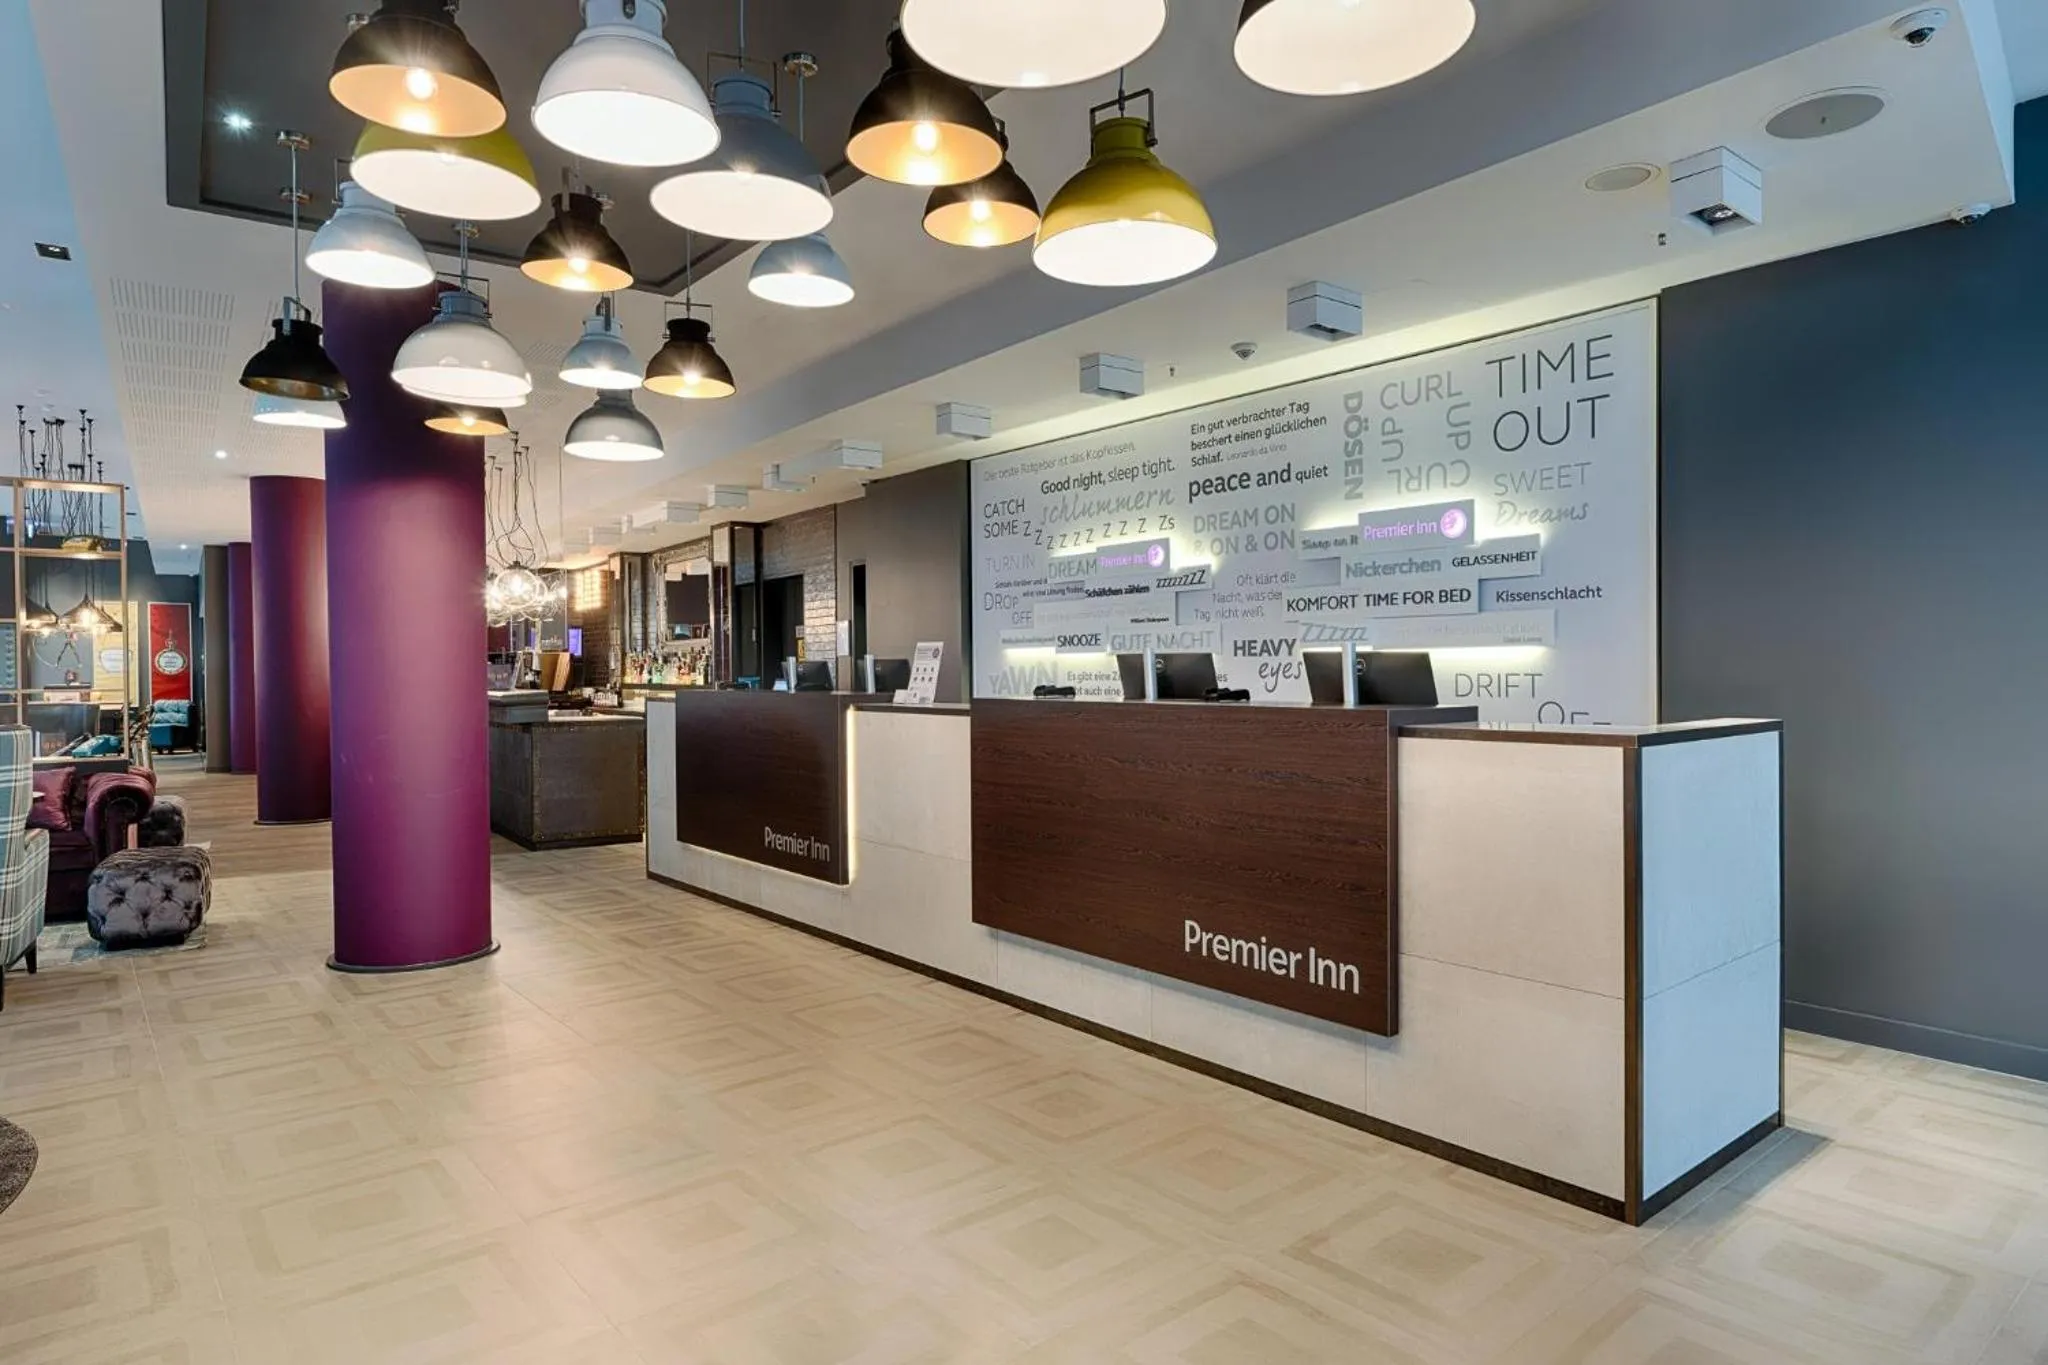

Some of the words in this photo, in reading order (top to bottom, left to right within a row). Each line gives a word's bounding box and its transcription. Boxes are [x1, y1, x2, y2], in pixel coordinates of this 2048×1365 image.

[1485, 334, 1614, 398] TIME
[1379, 371, 1463, 410] CURL
[1191, 424, 1206, 435] Ein
[1207, 421, 1224, 434] gut
[1225, 406, 1286, 427] verbrachter
[1288, 401, 1310, 414] Tag
[1446, 401, 1471, 451] UP
[1493, 394, 1611, 452] OUT
[1191, 434, 1232, 451] beschert
[1234, 428, 1263, 442] einen
[1264, 415, 1327, 439] glücklichen
[1343, 391, 1368, 500] DÖSEN
[1381, 416, 1404, 463] UP
[1191, 452, 1224, 468] Schlaf.
[1041, 477, 1071, 495] Good
[1072, 470, 1106, 492] night,
[1108, 464, 1140, 484] sleep
[1142, 458, 1176, 480] tight.
[1188, 471, 1252, 504] peace
[1256, 462, 1292, 488] and
[1295, 465, 1329, 484] quiet
[1387, 459, 1471, 494] CURL
[1493, 461, 1592, 496] SWEET
[983, 498, 1025, 519] CATCH
[1040, 488, 1176, 526] schlummern
[1193, 508, 1259, 534] DREAM
[1264, 503, 1296, 525] ON
[1493, 500, 1590, 527] Dreams
[983, 520, 1019, 539] SOME
[1023, 521, 1032, 537] Z
[1034, 529, 1042, 545] Z
[1158, 514, 1175, 531] Zs
[1210, 536, 1239, 556] ON
[1244, 534, 1258, 552] &
[1264, 529, 1295, 550] ON
[1363, 521, 1416, 540] Premier
[1416, 520, 1438, 534] Inn
[1048, 558, 1098, 580] DREAM
[1345, 558, 1442, 579] Nickerchen
[1452, 551, 1538, 568] GELASSENHEIT
[1085, 585, 1123, 599] Schäfchen
[1123, 584, 1150, 595] zählen
[1236, 574, 1253, 587] Oft
[1280, 571, 1297, 584] die
[984, 591, 1019, 611] DROP
[1286, 594, 1358, 613] KOMFORT
[1364, 592, 1399, 608] TIME
[1402, 590, 1434, 605] FOR
[1438, 588, 1471, 604] BED
[1495, 585, 1603, 604] Kissenschlacht
[1011, 610, 1033, 625] OFF
[1193, 608, 1211, 622] Tag
[1057, 633, 1101, 647] SNOOZE
[1111, 634, 1151, 652] GUTE
[1156, 630, 1215, 650] NACHT
[1233, 638, 1297, 657] HEAVY
[988, 660, 1058, 697] YAWN
[1258, 660, 1303, 693] eyes
[1454, 672, 1543, 698] DRIFT
[764, 826, 809, 857] Premier
[811, 835, 830, 862] Inn
[1184, 919, 1302, 979] Premier
[1308, 946, 1360, 994] Inn
